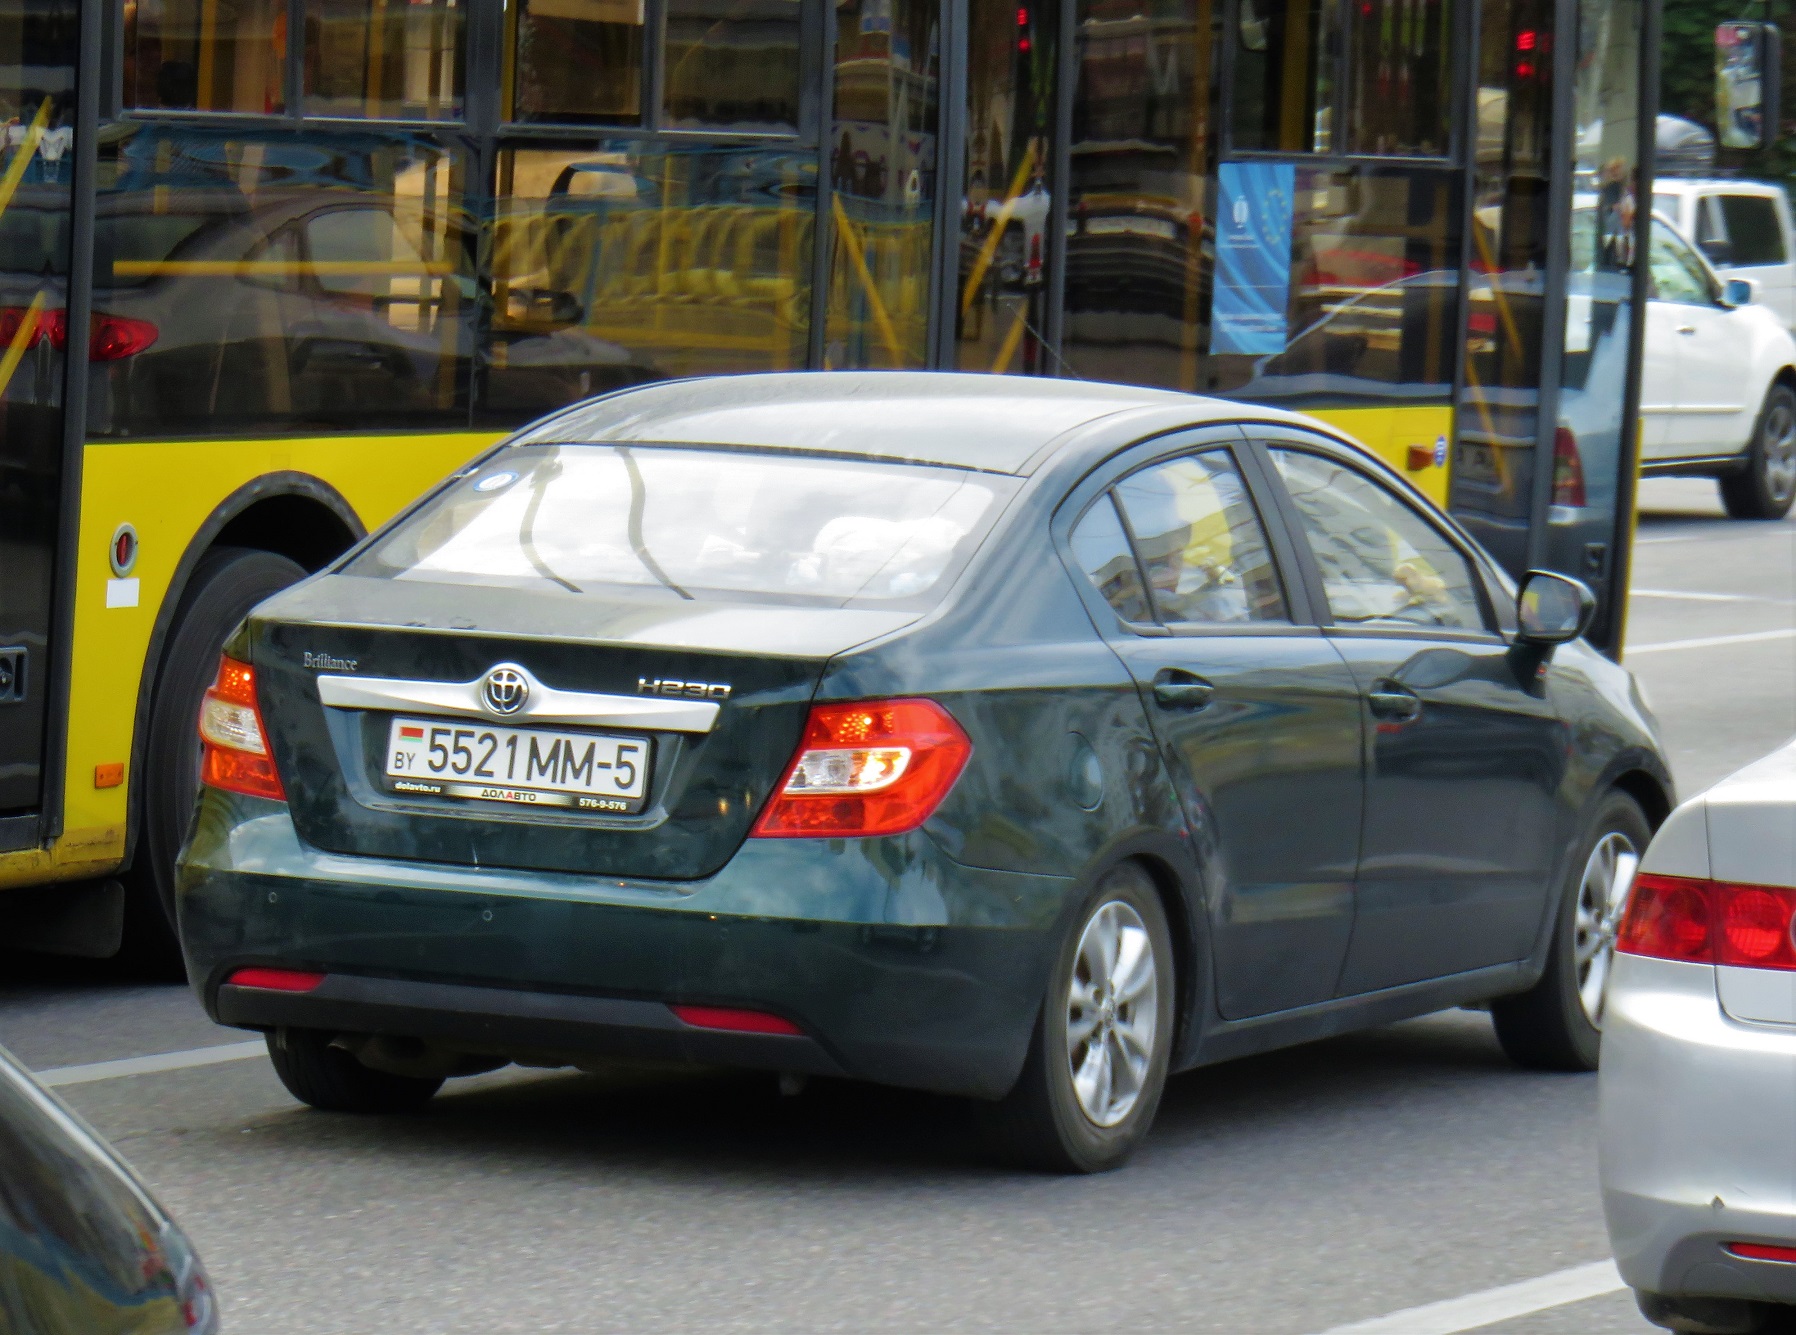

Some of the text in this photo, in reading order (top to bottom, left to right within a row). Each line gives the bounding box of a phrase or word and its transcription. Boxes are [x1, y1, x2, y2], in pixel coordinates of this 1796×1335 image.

[303, 651, 358, 671] Brilliance
[638, 678, 731, 699] H230
[393, 751, 416, 770] BY
[394, 781, 441, 793] dolavto.ru
[579, 797, 627, 811] 576-9-576
